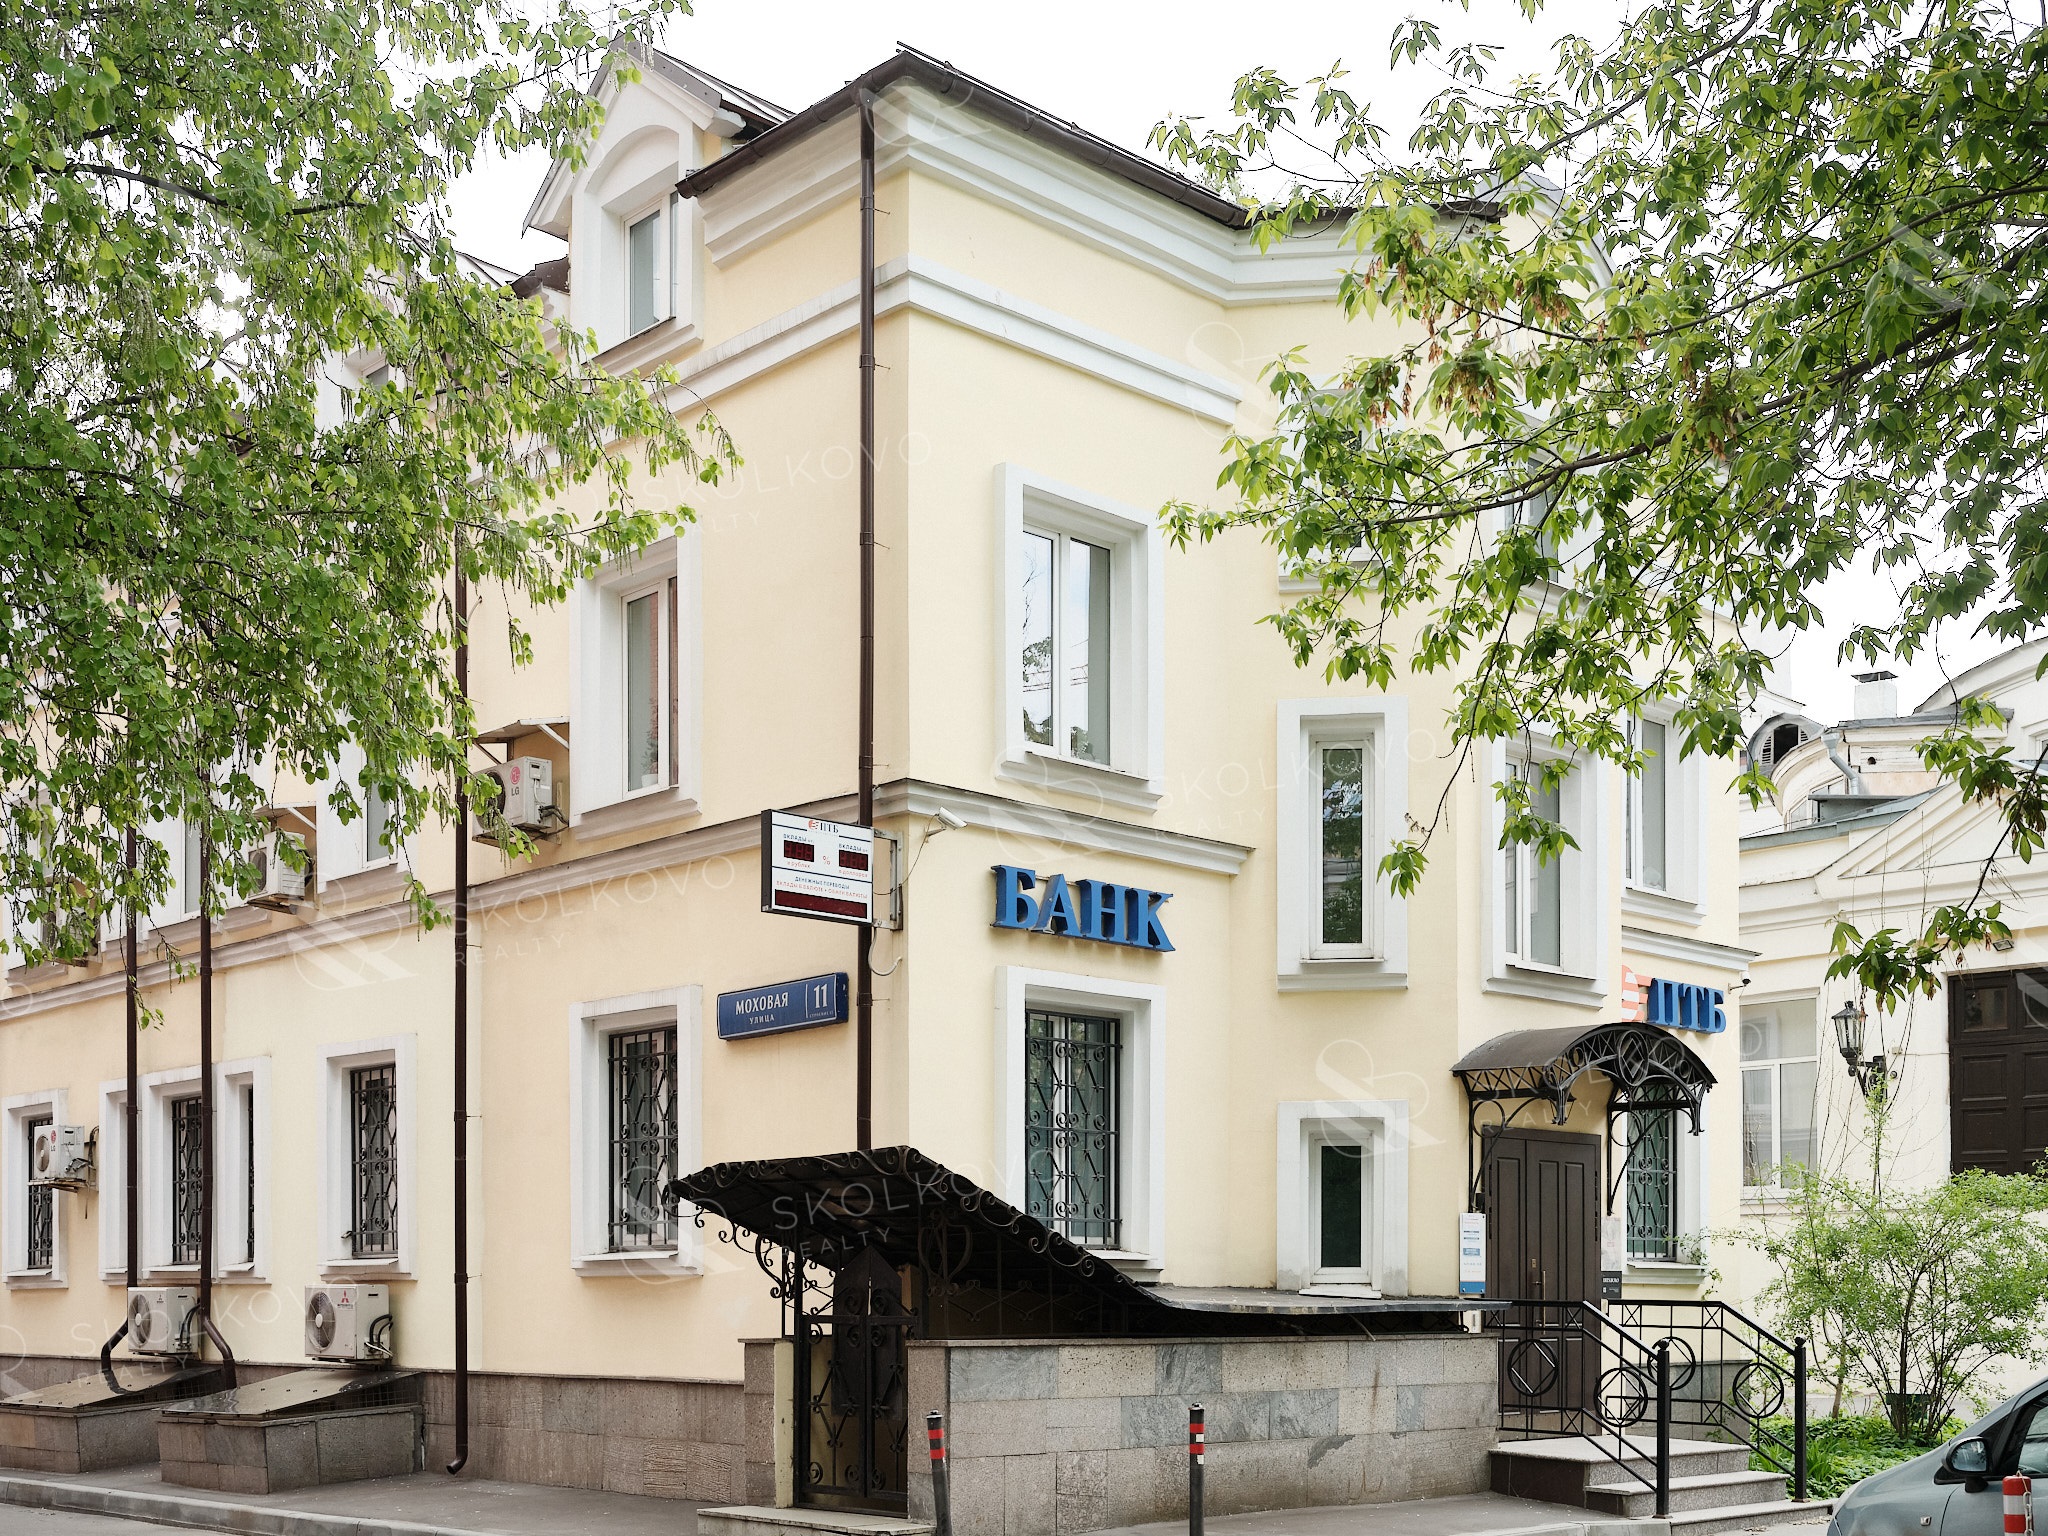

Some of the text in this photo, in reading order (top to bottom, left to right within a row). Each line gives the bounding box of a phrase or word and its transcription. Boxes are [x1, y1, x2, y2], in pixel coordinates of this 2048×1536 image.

[511, 787, 520, 796] LG
[820, 822, 839, 834] ПТБ
[783, 833, 807, 842] ВКЛАДЫ
[838, 843, 862, 852] ВКЛАДЫ
[990, 864, 1176, 952] БАНК
[813, 983, 828, 1009] 11
[735, 992, 789, 1015] МОХОВАЯ
[1646, 977, 1727, 1035] ПТБ
[749, 1013, 775, 1025] УЛИЦА
